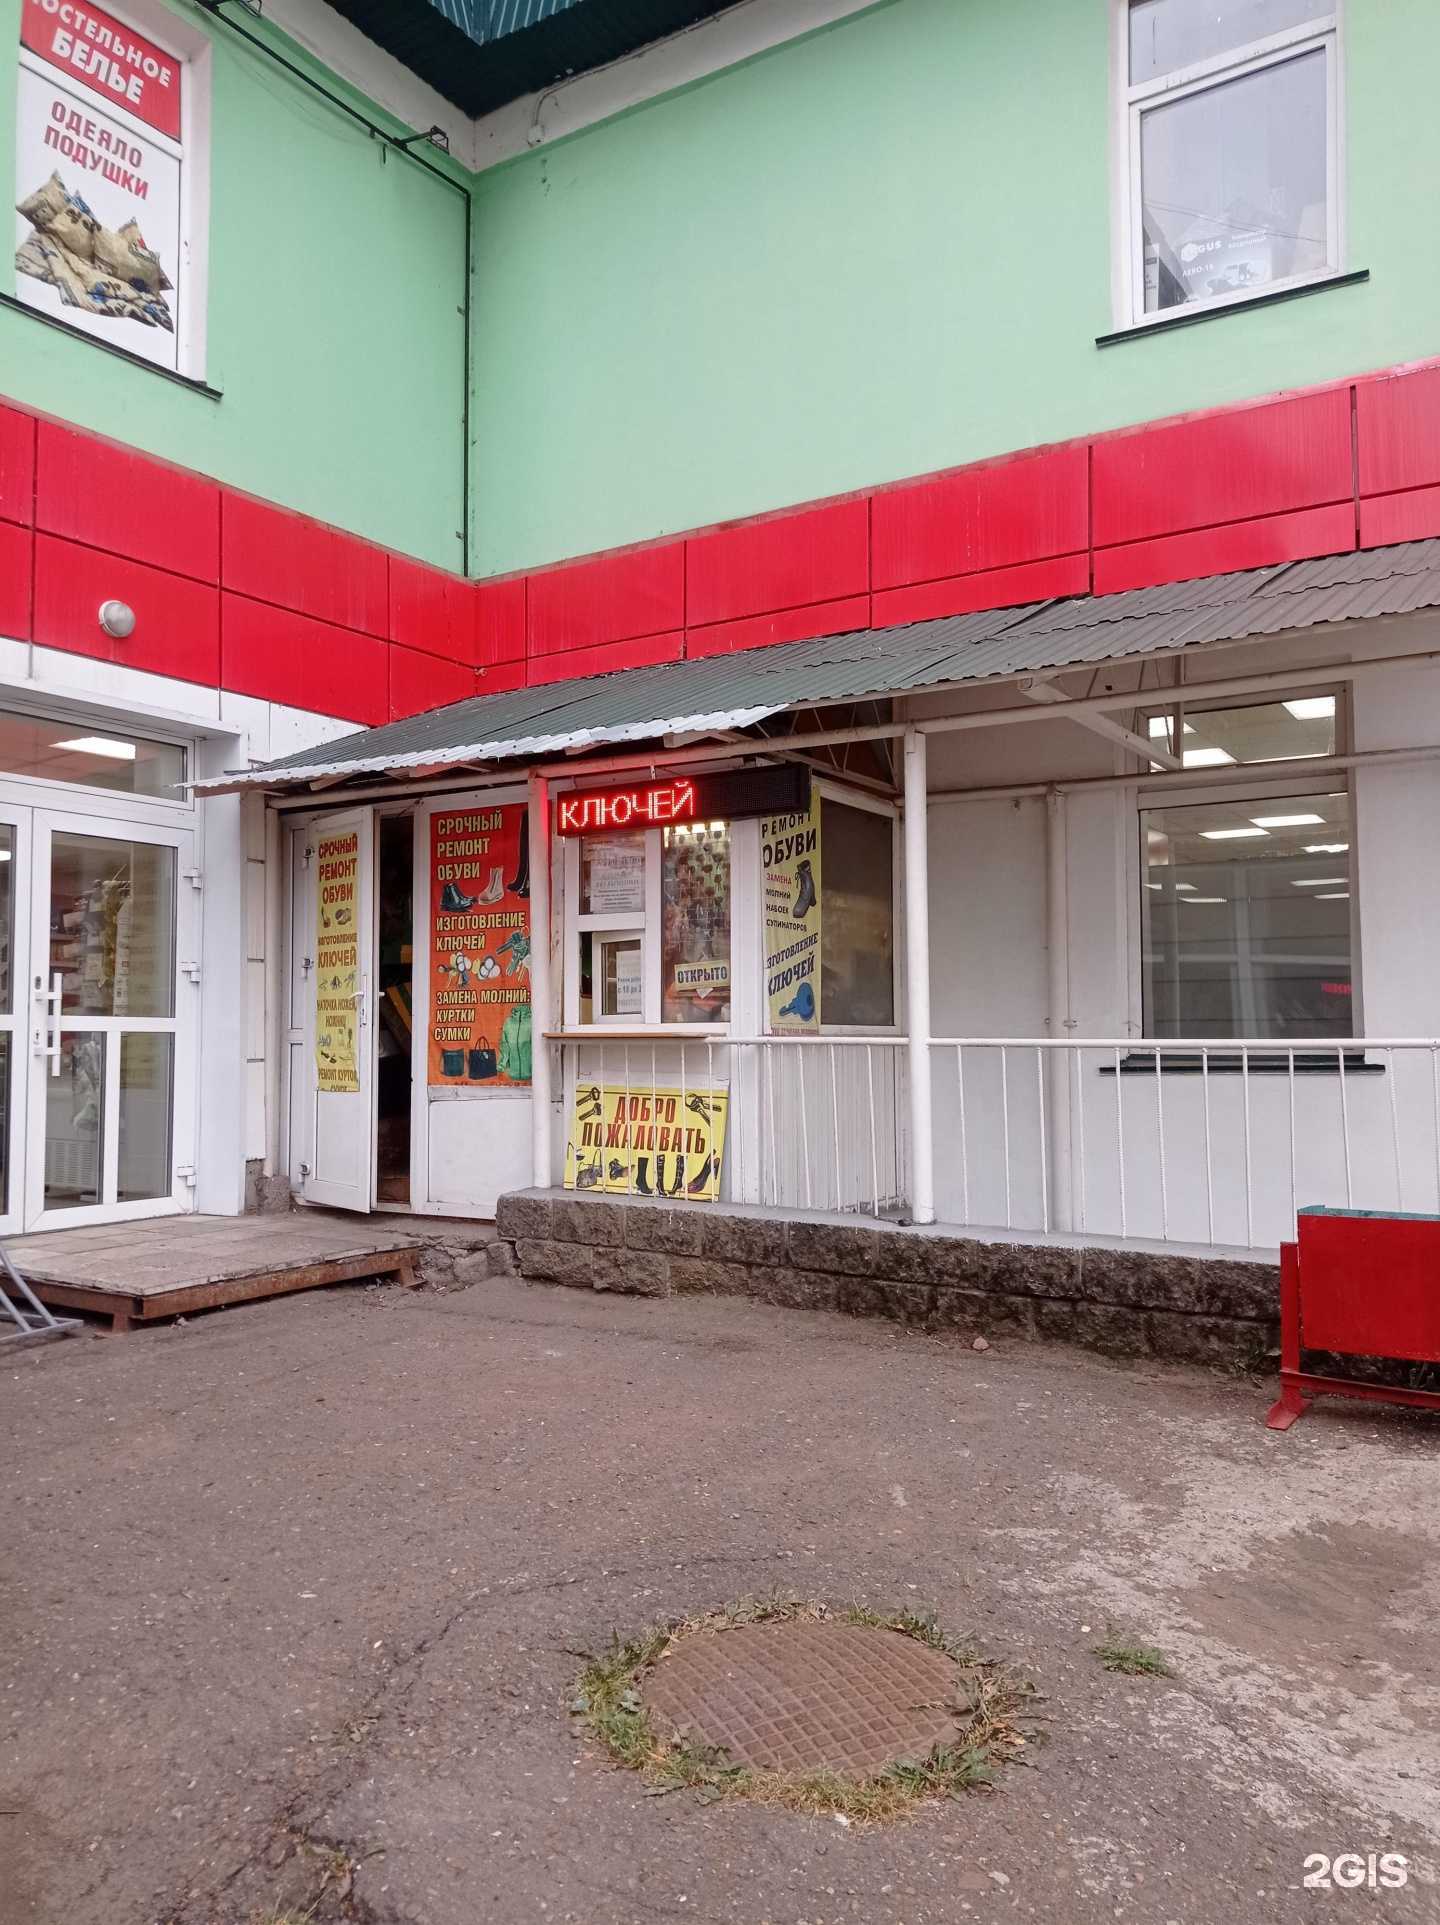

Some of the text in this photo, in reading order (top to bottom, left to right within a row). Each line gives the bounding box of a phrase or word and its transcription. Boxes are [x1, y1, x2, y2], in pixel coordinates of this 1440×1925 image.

[32, 0, 171, 88] ОСТЕЛЬНОЕ
[51, 27, 144, 105] БЕЛЬЕ
[51, 100, 143, 169] ОДЕЯЛО
[43, 125, 149, 200] ПОДУШКИ
[562, 781, 694, 829] КЛЮЧЕЙ
[437, 810, 503, 836] СРОЧНЫЙ
[318, 833, 358, 859] СРОЧНЫЙ
[437, 838, 491, 858] РЕМОНТ
[762, 828, 817, 868] ОБУВИ
[319, 857, 357, 882] РЕМОНТ
[437, 861, 480, 882] ОБУВИ
[766, 872, 792, 885] ЗАМЕНА
[322, 884, 353, 905] ОБУВИ
[766, 887, 791, 900] МОЛНИЙ
[766, 903, 789, 915] НАБОЕК
[436, 911, 526, 932] ИЗГОТОВЛЕНИЕ
[766, 918, 808, 932] СУПИНАТОРОВ
[318, 932, 358, 946] ИЗГОТОВЛЕНИЕ
[436, 932, 486, 953] КЛЮЧЕЙ
[318, 948, 357, 968] КЛЮЧЕЙ
[766, 932, 819, 970] ЗГОТОВЛЕНИЕ
[677, 965, 729, 985] ОТКРЫТО
[436, 987, 531, 1005] ЗАМЕНА МОЛНИЙ:
[436, 1007, 475, 1024] КУРТКИ
[434, 1026, 471, 1042] СУМКИ
[318, 1068, 337, 1082] РЕМОНТ
[614, 1096, 676, 1124] ДОБРО
[582, 1122, 706, 1154] ПОЖАЛОВАТЬ
